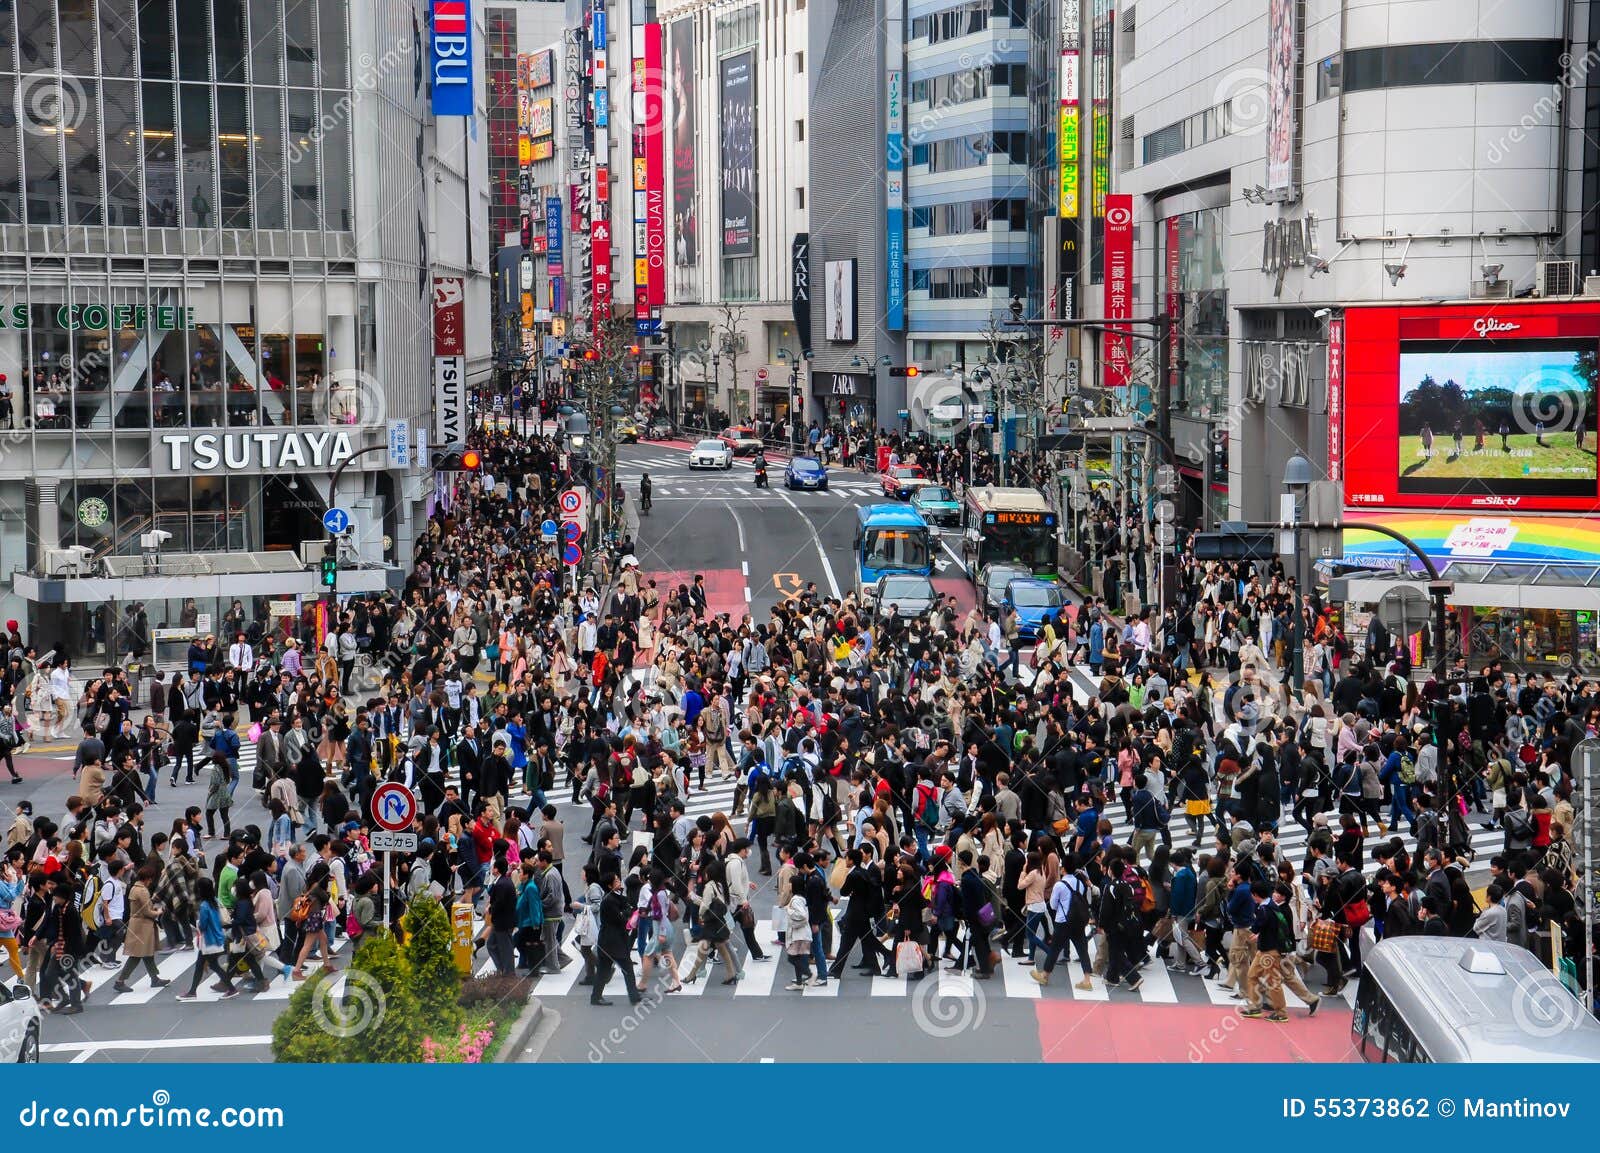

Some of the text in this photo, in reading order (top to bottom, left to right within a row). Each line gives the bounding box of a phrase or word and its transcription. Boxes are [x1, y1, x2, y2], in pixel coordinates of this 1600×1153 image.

[565, 29, 581, 127] KARAOKE
[547, 207, 558, 248] 渋谷整形
[795, 244, 808, 301] ZARA
[891, 232, 899, 306] 三井住友信託銀行
[57, 304, 196, 331] COFFEE
[1473, 317, 1521, 338] Glico
[443, 357, 457, 445] TSUTAYA
[832, 375, 857, 394] ZARA
[162, 432, 356, 471] TSUTAYA
[374, 836, 414, 848] ここから
